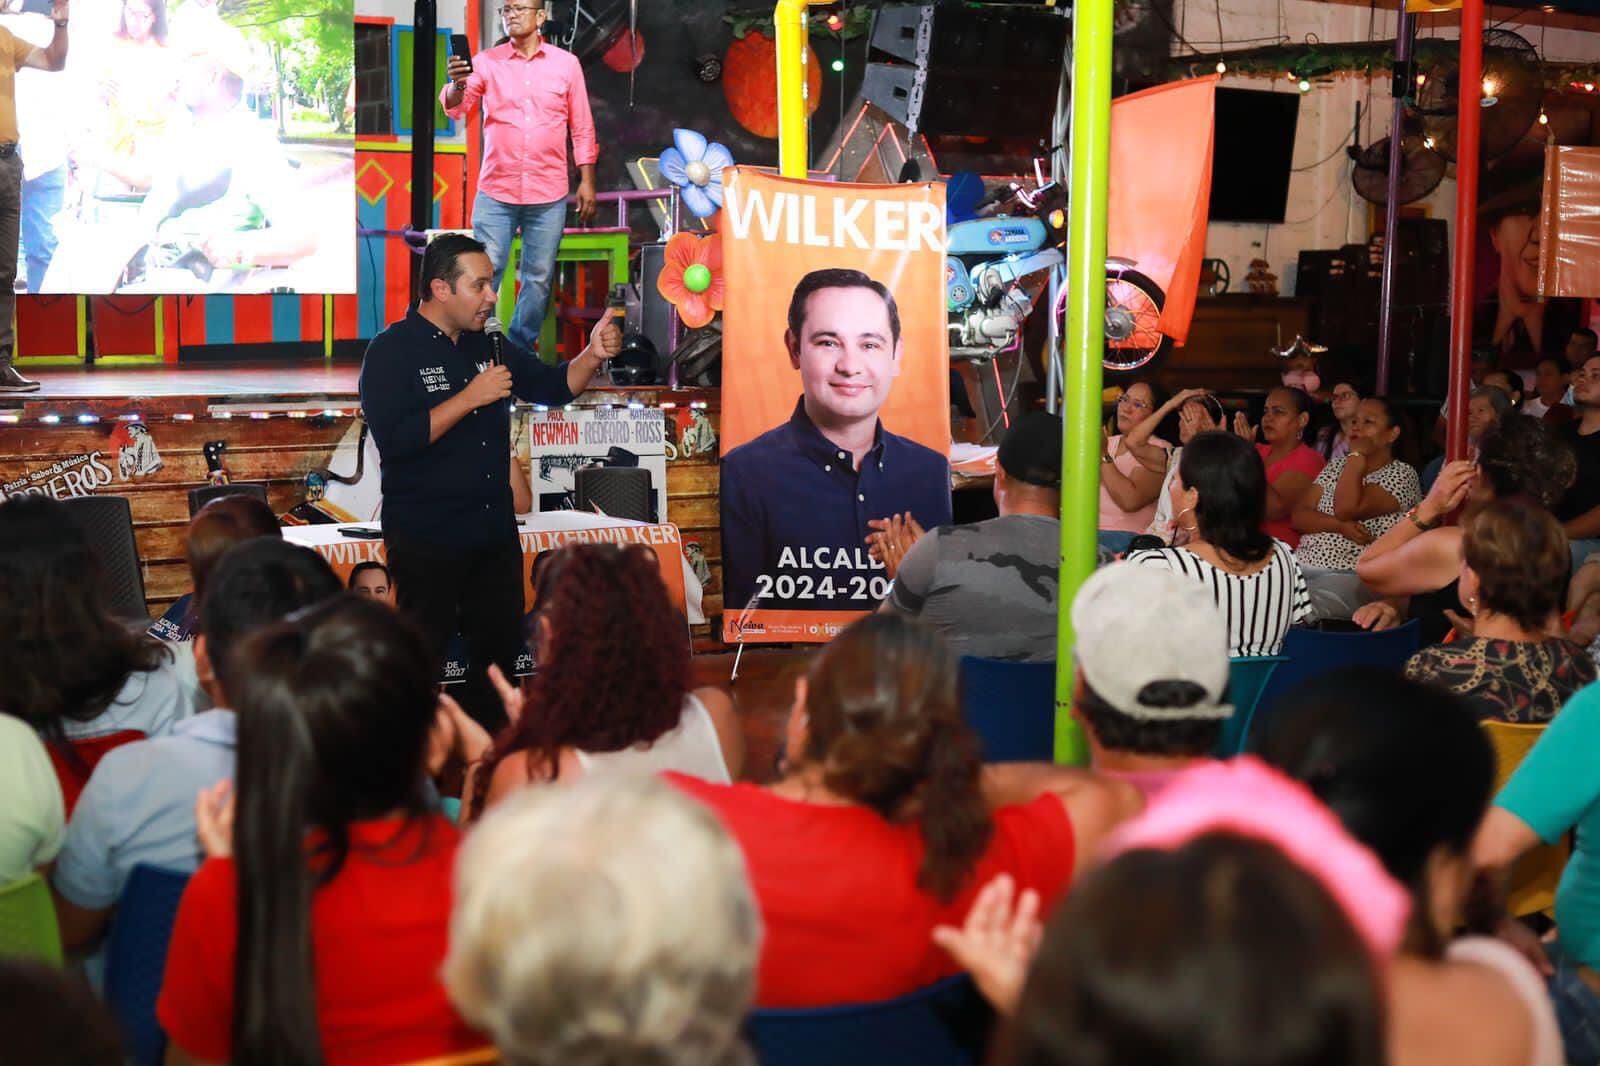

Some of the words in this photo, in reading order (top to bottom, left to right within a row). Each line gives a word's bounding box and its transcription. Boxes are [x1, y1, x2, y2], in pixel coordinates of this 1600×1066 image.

[722, 185, 948, 253] WILKER
[422, 374, 448, 385] NEIVA
[546, 411, 565, 421] PAUL
[533, 422, 579, 446] NEWMAN
[584, 421, 630, 444] REDFORD
[635, 421, 662, 443] ROSS
[31, 469, 53, 481] Sabor
[52, 464, 63, 473] &
[320, 543, 387, 566] WILK
[777, 546, 886, 570] ALCALD
[755, 574, 889, 601] 2024-20
